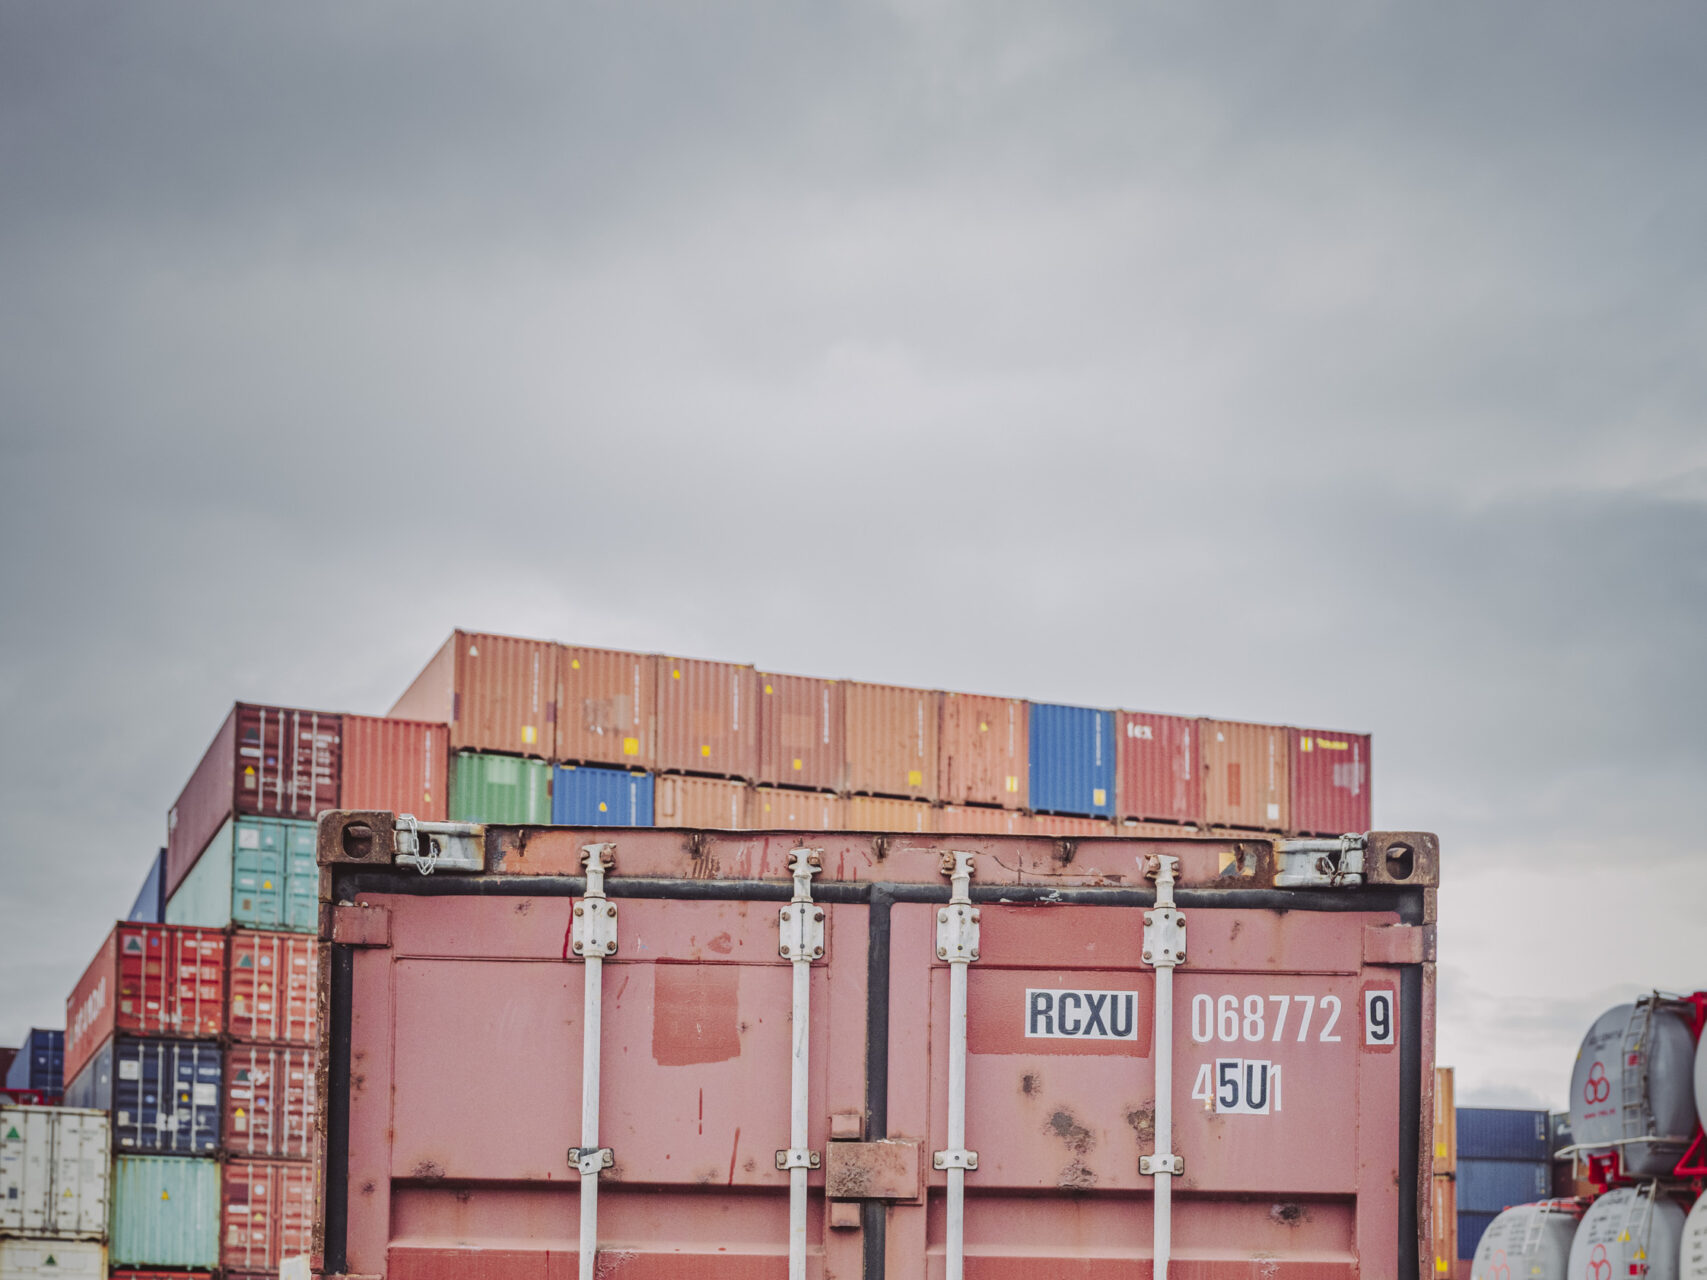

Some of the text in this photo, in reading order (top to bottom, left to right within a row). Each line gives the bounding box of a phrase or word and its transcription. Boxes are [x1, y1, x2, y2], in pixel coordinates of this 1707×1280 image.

[1030, 991, 1391, 1043] RCXU 068772 9
[1191, 1061, 1282, 1112] 45U1
